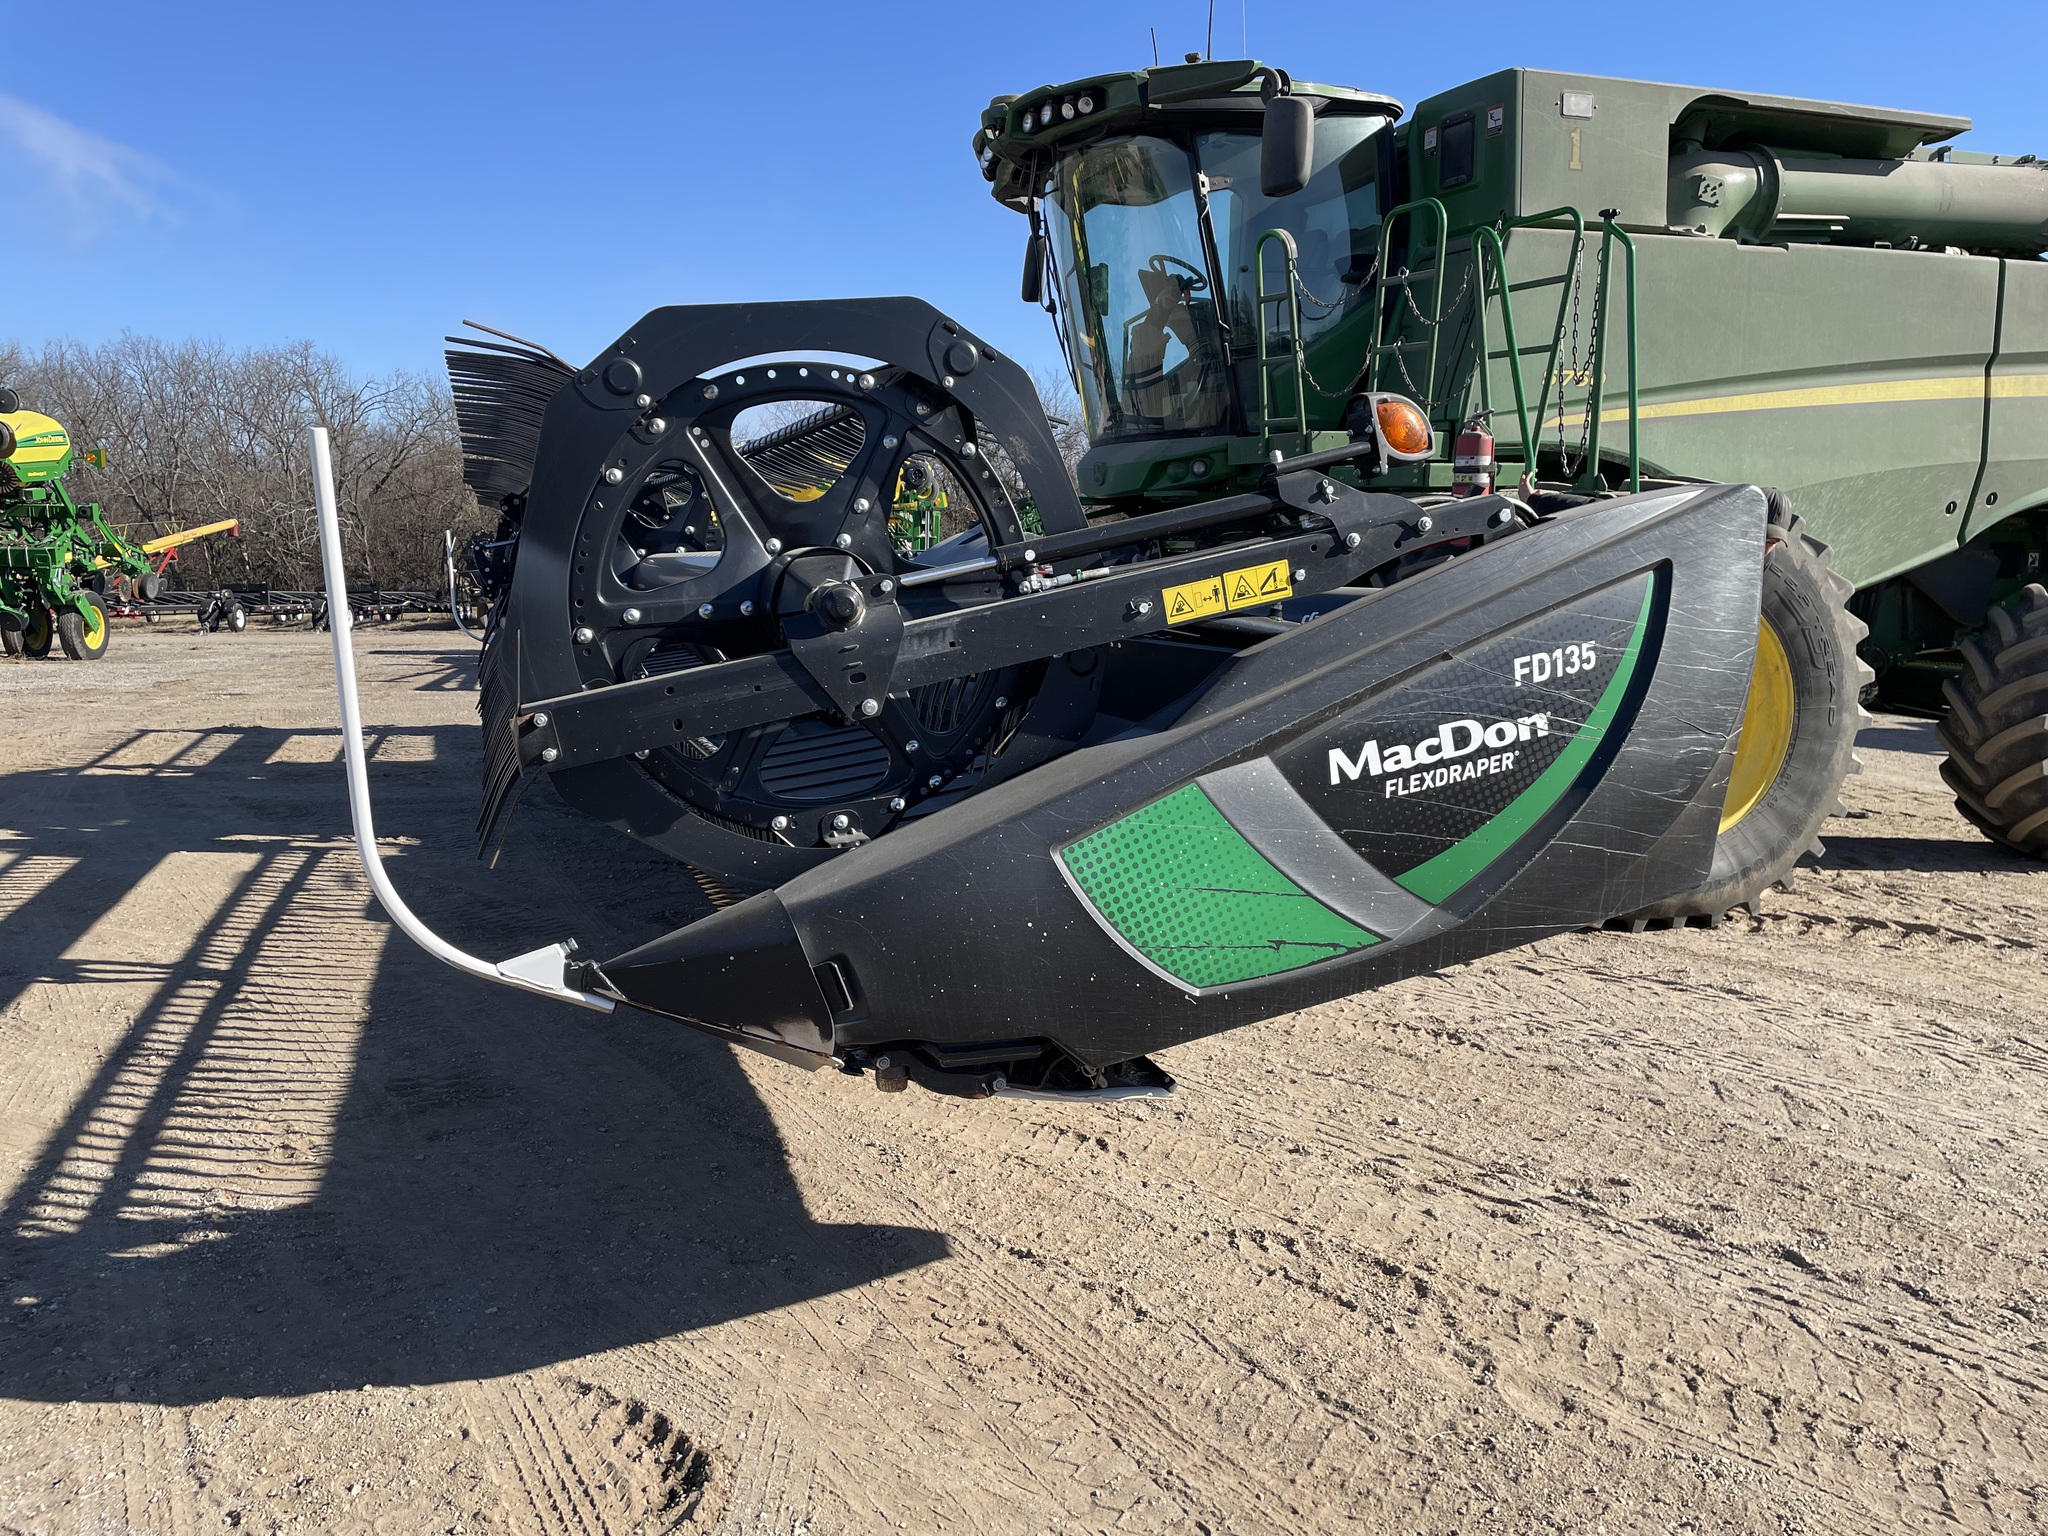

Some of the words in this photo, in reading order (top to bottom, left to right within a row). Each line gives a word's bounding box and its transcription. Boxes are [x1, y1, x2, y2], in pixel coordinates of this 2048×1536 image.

[1568, 127, 1583, 171] 1
[1513, 640, 1597, 687] FD135
[1328, 713, 1550, 786] MacDon
